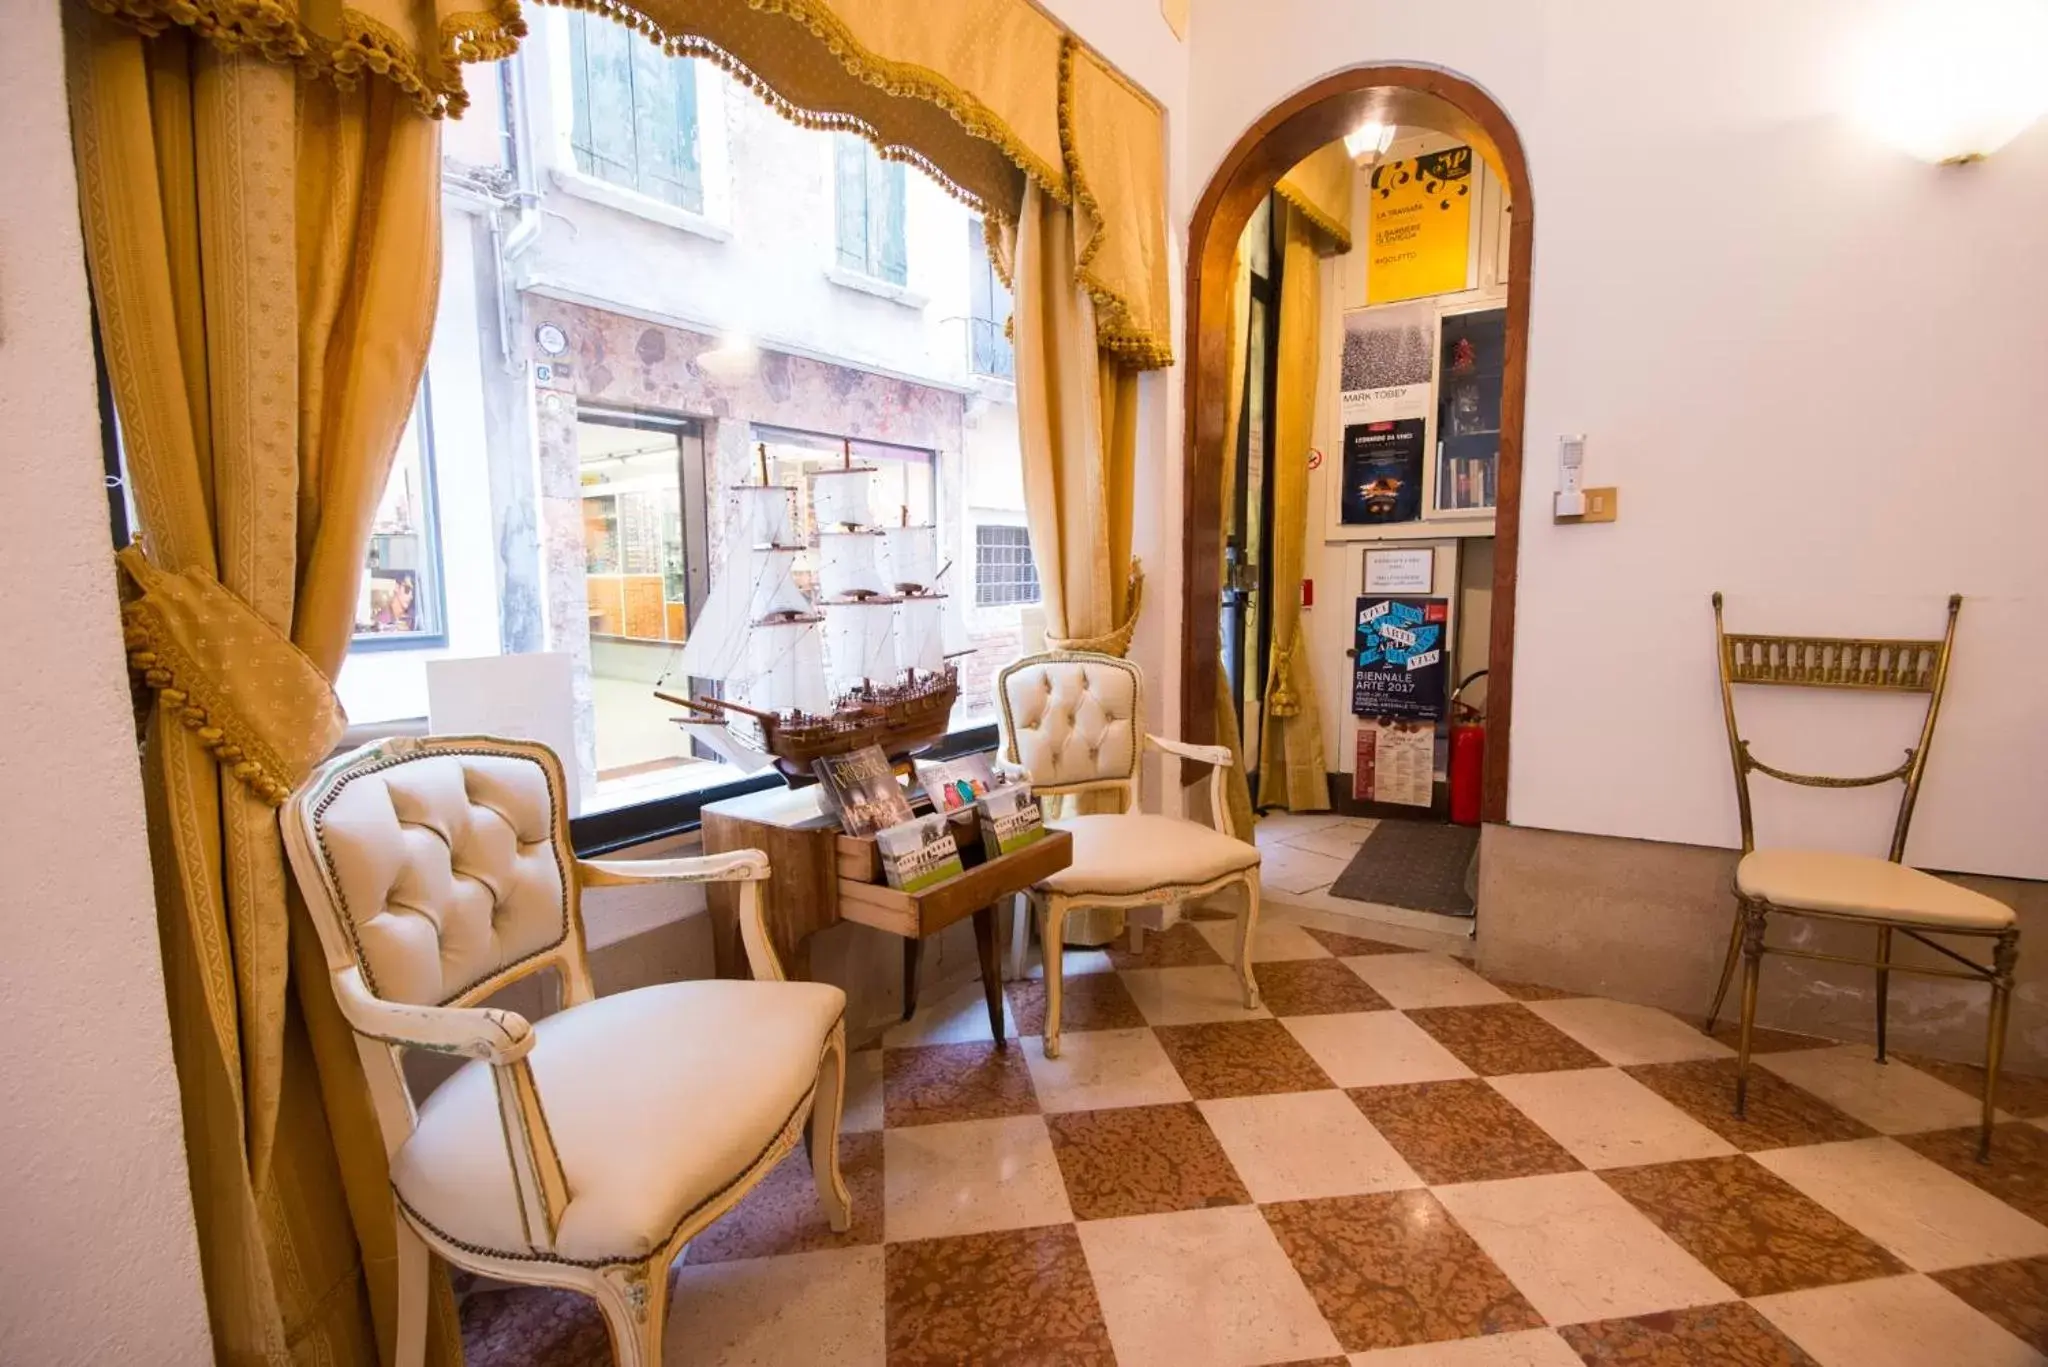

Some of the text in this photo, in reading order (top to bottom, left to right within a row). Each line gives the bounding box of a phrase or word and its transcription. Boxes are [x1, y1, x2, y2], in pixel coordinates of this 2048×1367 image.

[1343, 388, 1407, 402] MARK TOBEY
[1356, 671, 1412, 682] BIENNALE
[1356, 681, 1416, 694] ARTE 2017
